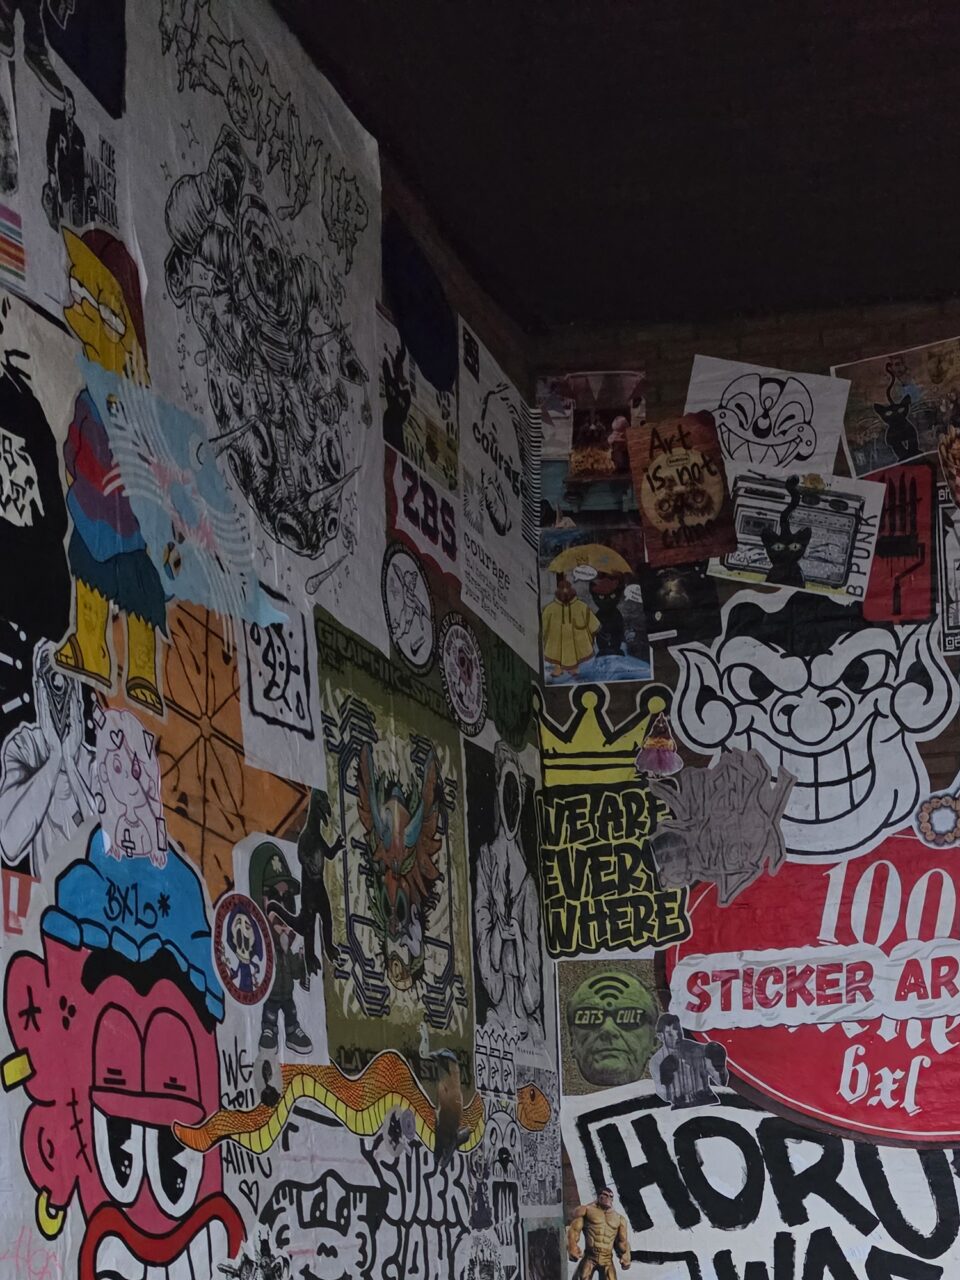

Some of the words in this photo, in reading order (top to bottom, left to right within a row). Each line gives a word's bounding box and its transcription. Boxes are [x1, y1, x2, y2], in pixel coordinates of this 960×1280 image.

[650, 424, 693, 457] Art
[645, 463, 666, 493] is
[676, 452, 718, 486] not
[849, 514, 878, 578] PUNK
[541, 794, 597, 847] WE
[597, 788, 673, 845] ARE
[547, 888, 686, 953] WHERE
[686, 958, 876, 1015] STICKER
[574, 1008, 604, 1026] CATS
[615, 1008, 645, 1025] CULT
[223, 1036, 254, 1087] WE
[380, 1138, 473, 1228] SUPER
